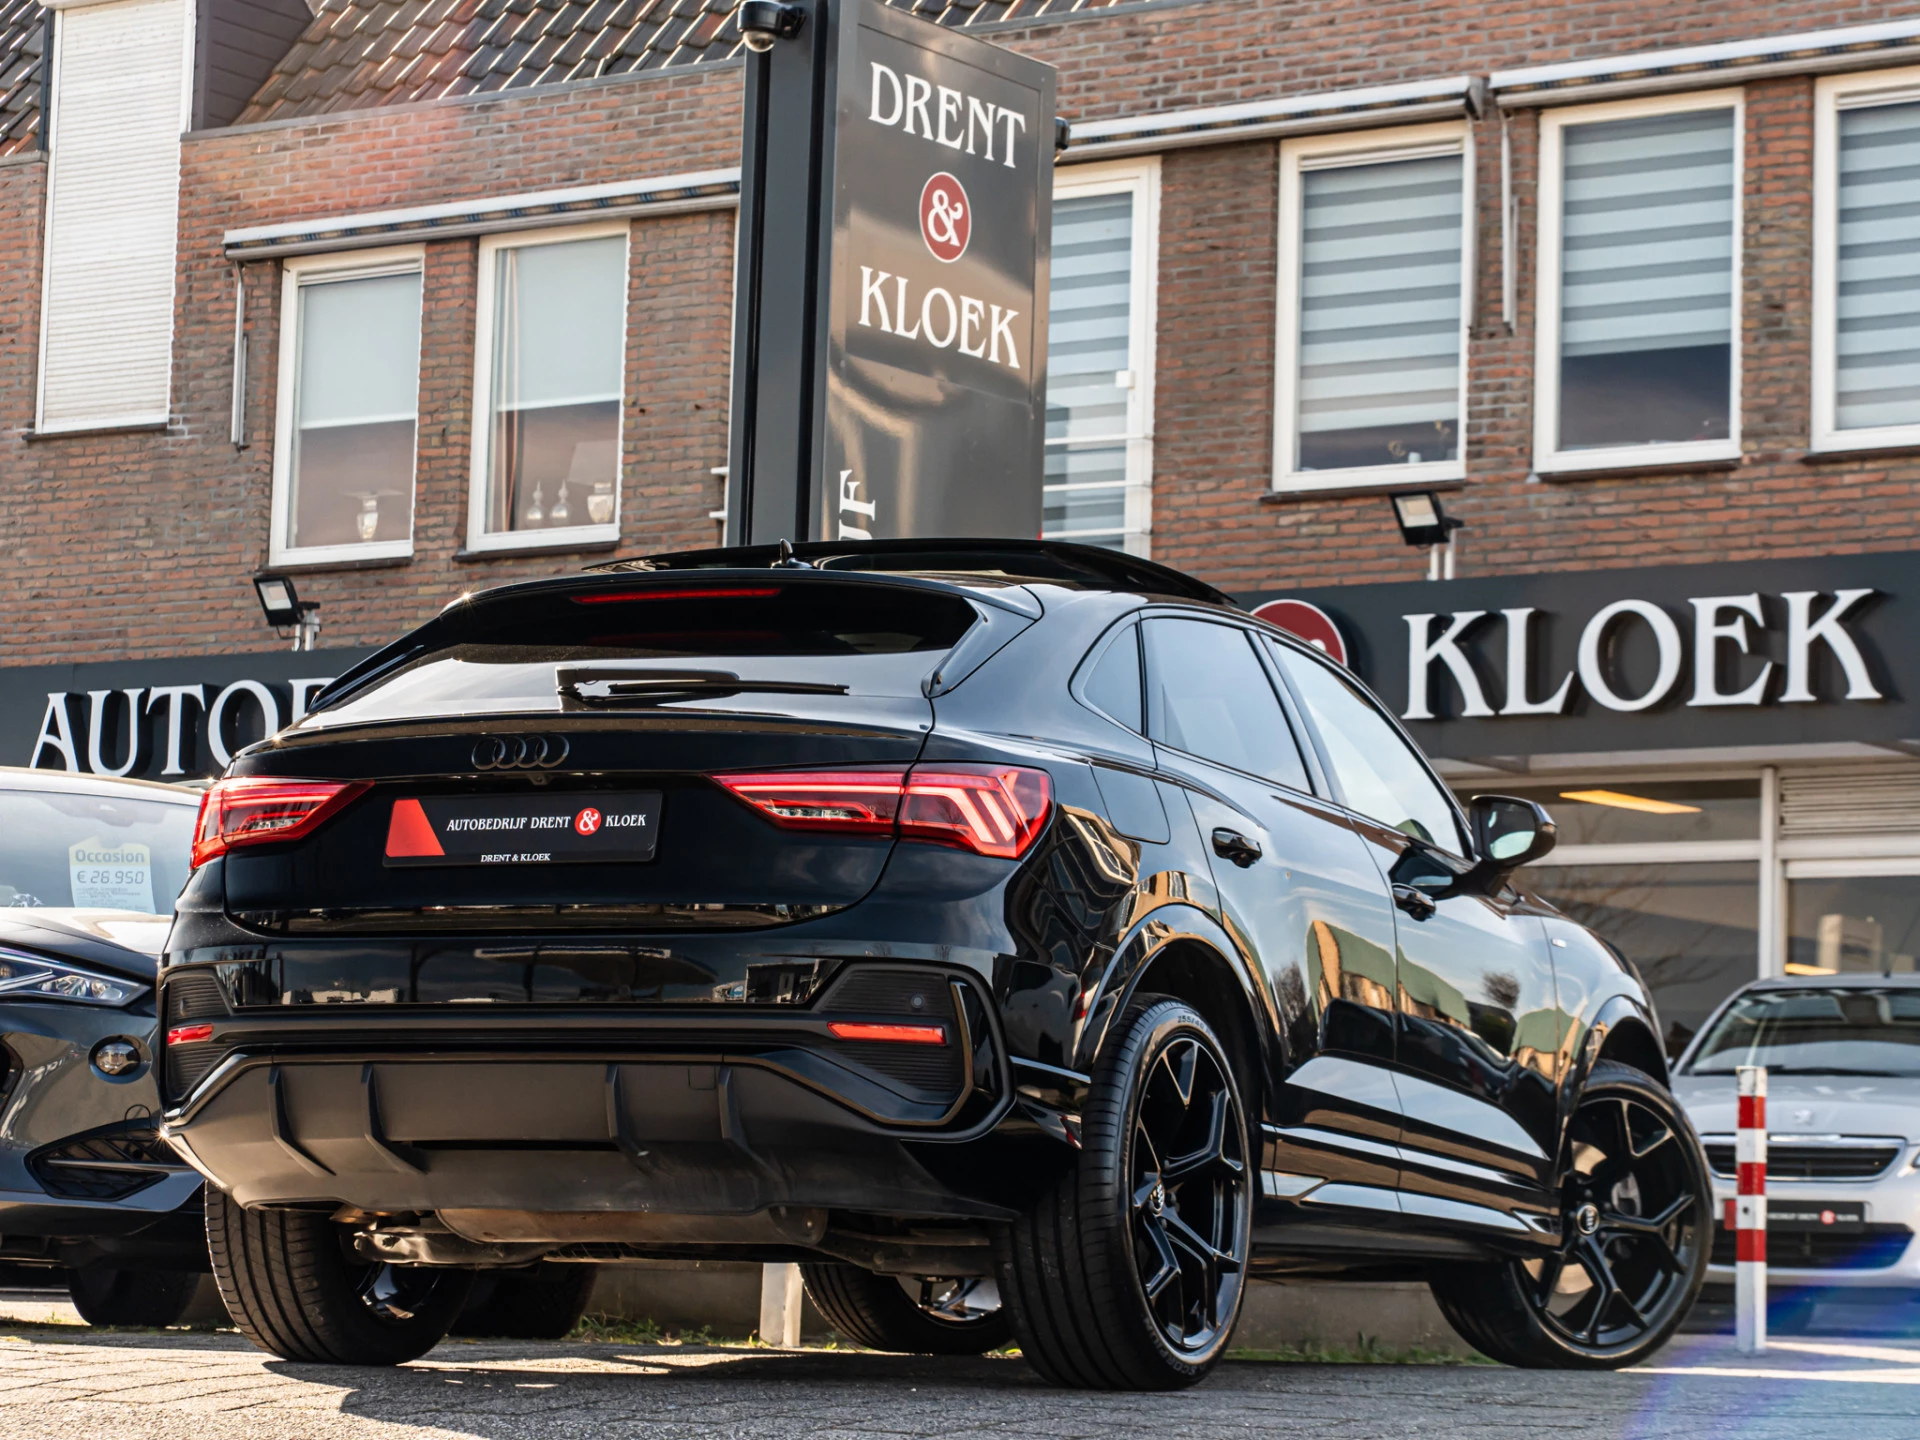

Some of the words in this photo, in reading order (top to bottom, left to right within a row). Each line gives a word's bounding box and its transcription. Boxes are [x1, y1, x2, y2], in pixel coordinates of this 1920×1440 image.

[868, 61, 1026, 168] DRENT
[927, 188, 963, 247] &
[858, 265, 1020, 370] KLOEK
[1400, 588, 1883, 720] KLOEK
[446, 817, 527, 832] AUTOBEDRIJF
[530, 816, 571, 829] DRENT
[579, 810, 599, 832] &
[605, 814, 646, 827] KLOEK
[75, 849, 145, 863] Occasion
[480, 854, 511, 863] DRENT
[511, 854, 519, 862] &
[520, 853, 551, 862] KLOEK
[77, 870, 87, 884] €
